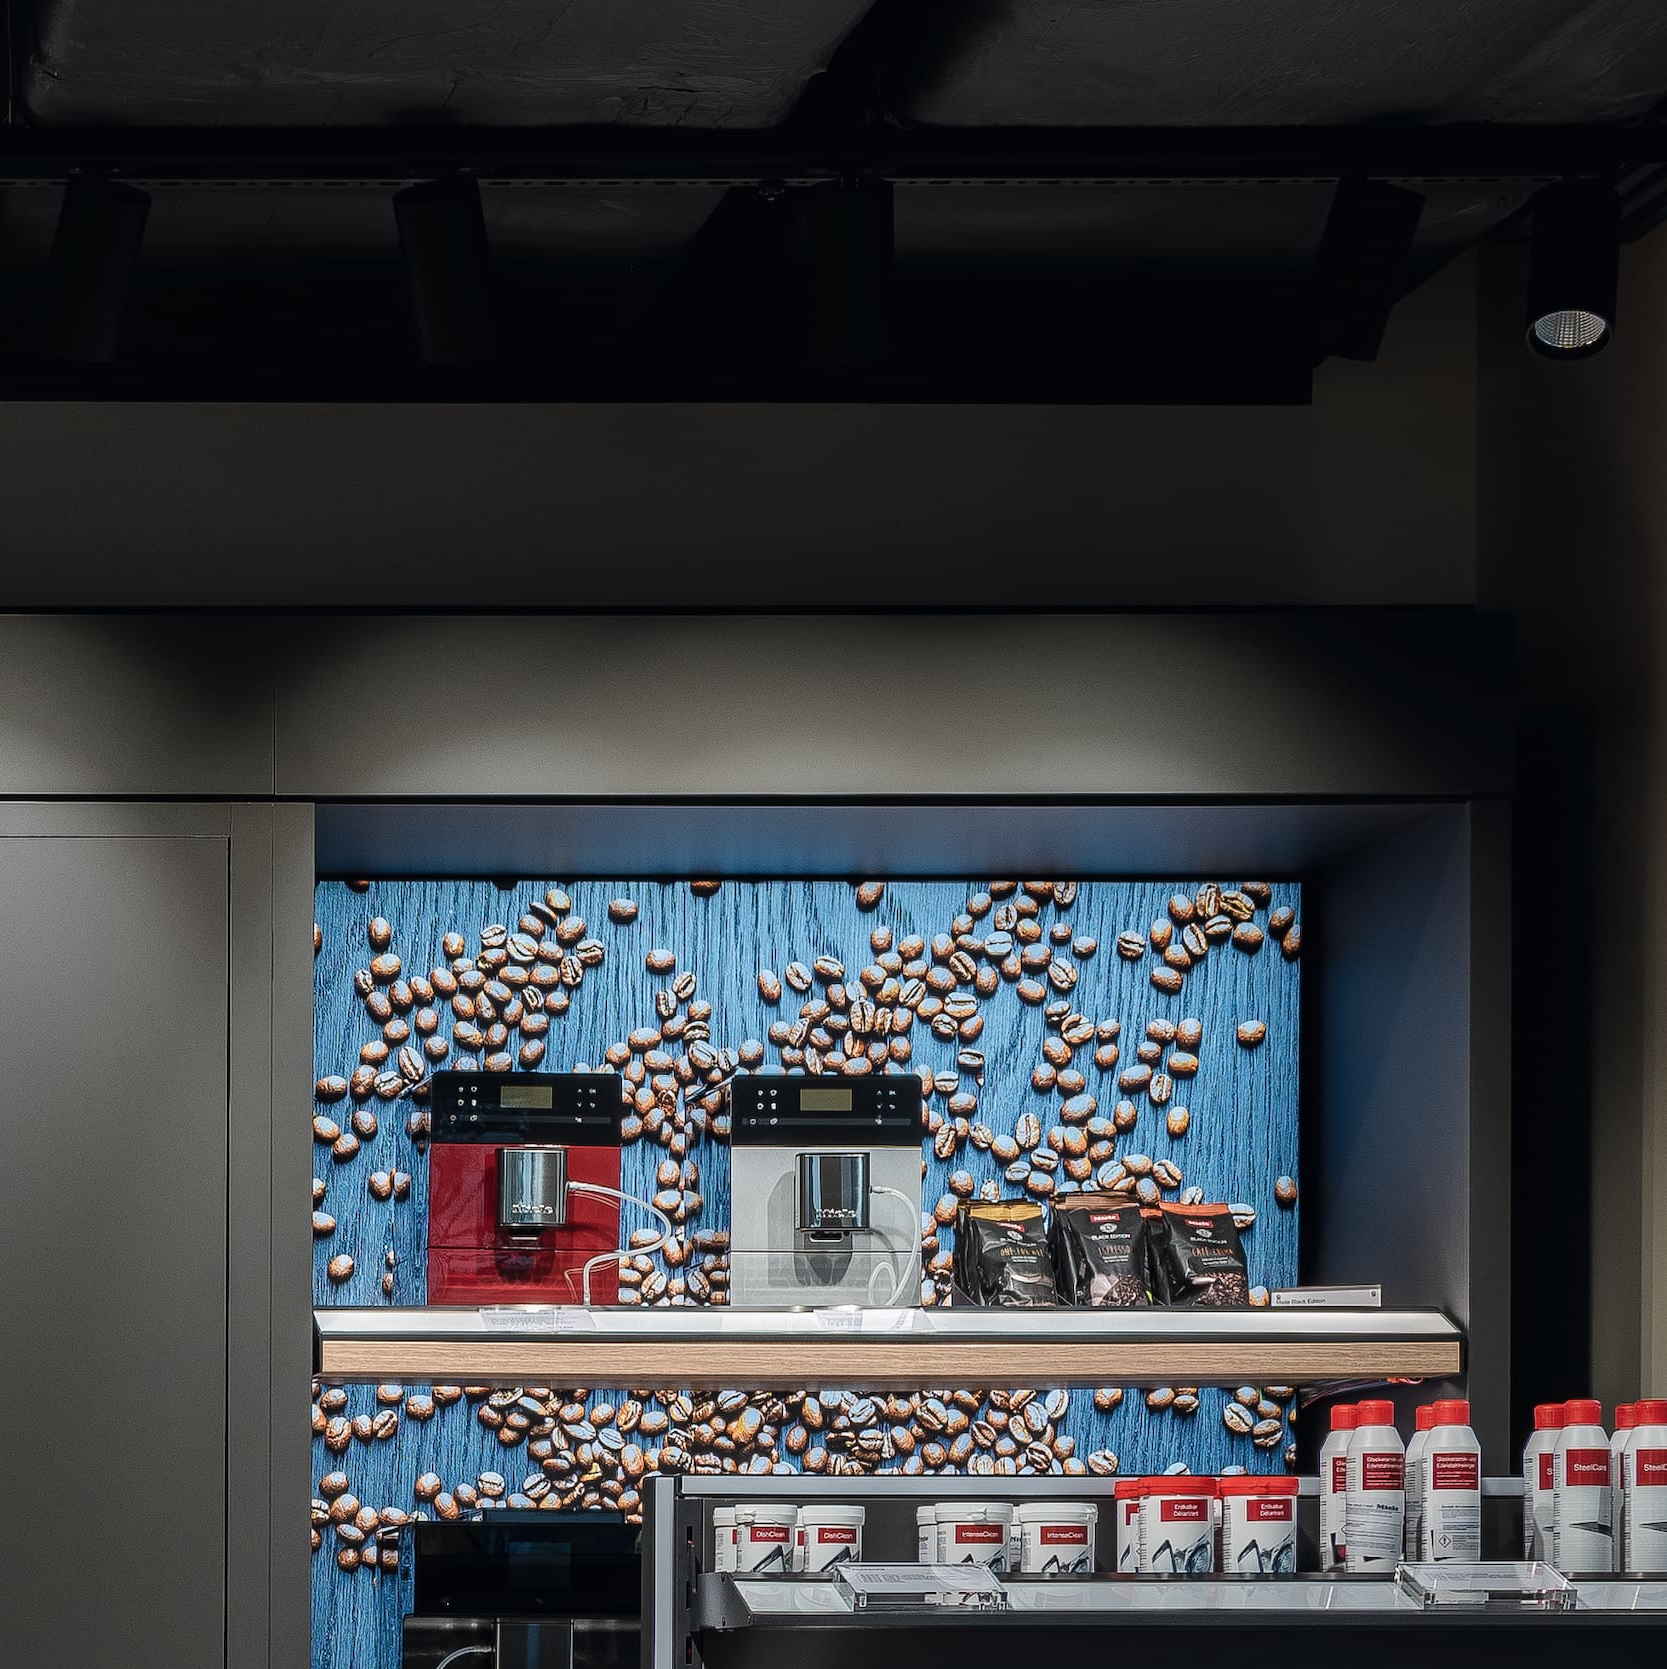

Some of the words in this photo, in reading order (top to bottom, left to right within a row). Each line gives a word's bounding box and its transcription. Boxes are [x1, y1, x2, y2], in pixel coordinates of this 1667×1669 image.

[1098, 1244, 1131, 1256] ESPRESSO
[1573, 1463, 1607, 1472] SteelCare
[1643, 1463, 1667, 1472] SteelC
[756, 1530, 786, 1538] DishClean
[823, 1531, 853, 1540] DishClean
[961, 1530, 999, 1538] IntenseClean
[1046, 1531, 1084, 1539] IntenseClean
